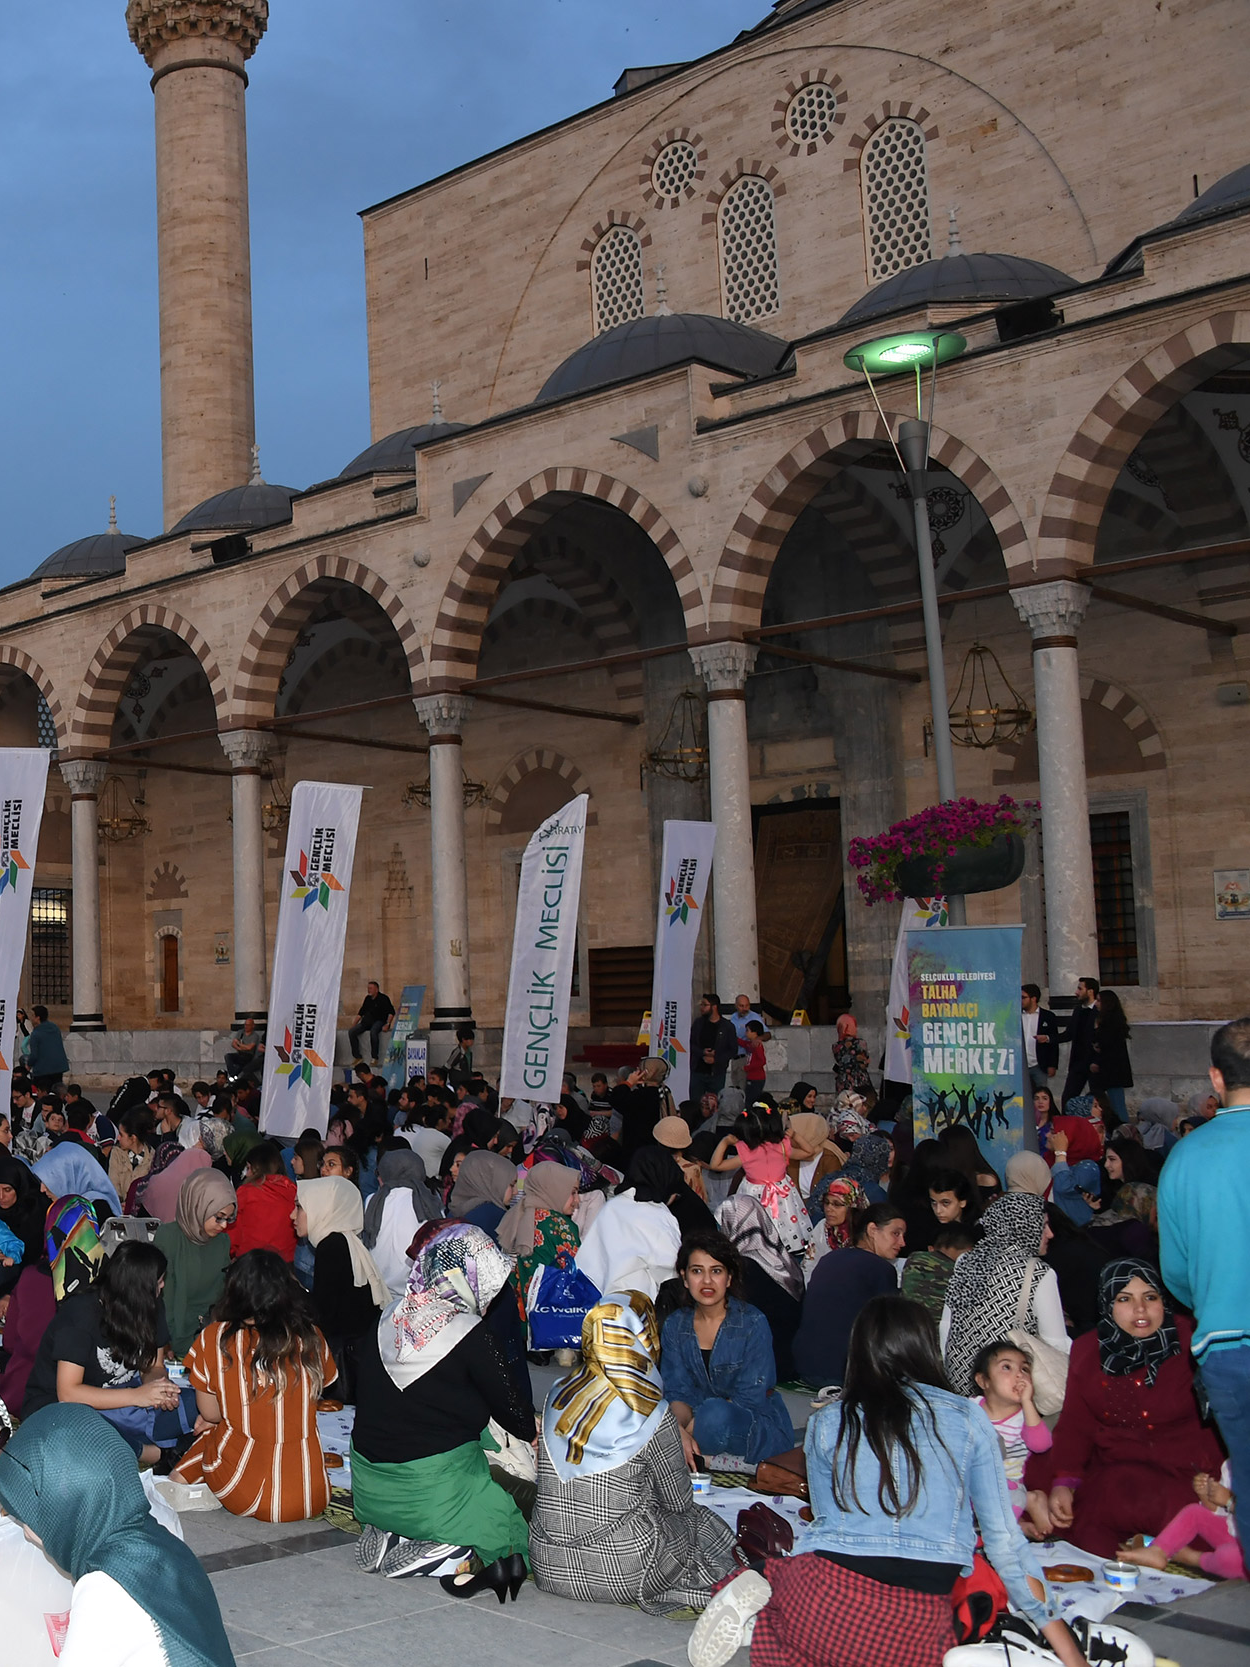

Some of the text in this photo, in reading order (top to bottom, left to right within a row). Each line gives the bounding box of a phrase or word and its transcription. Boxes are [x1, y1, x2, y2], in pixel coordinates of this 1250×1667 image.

[2, 799, 12, 849] GENÇLİK
[10, 799, 23, 849] MECLİSİ
[310, 827, 324, 871] GENÇLİK
[322, 827, 336, 872] MECLİSİ
[677, 858, 690, 893] GENÇLİK
[684, 858, 697, 895] MECLİSİ
[523, 846, 569, 1090] GENÇLİK MECLİSİ
[920, 971, 996, 983] SELÇUKLU BELEDİYESİ
[921, 984, 958, 1000] TALHA
[921, 1002, 978, 1019] BAYRAKÇI
[294, 1003, 305, 1048] GENÇLİK
[304, 1003, 317, 1049] MECLİSİ
[922, 1021, 997, 1047] GENÇLİK
[923, 1047, 1015, 1076] MERKEZİ
